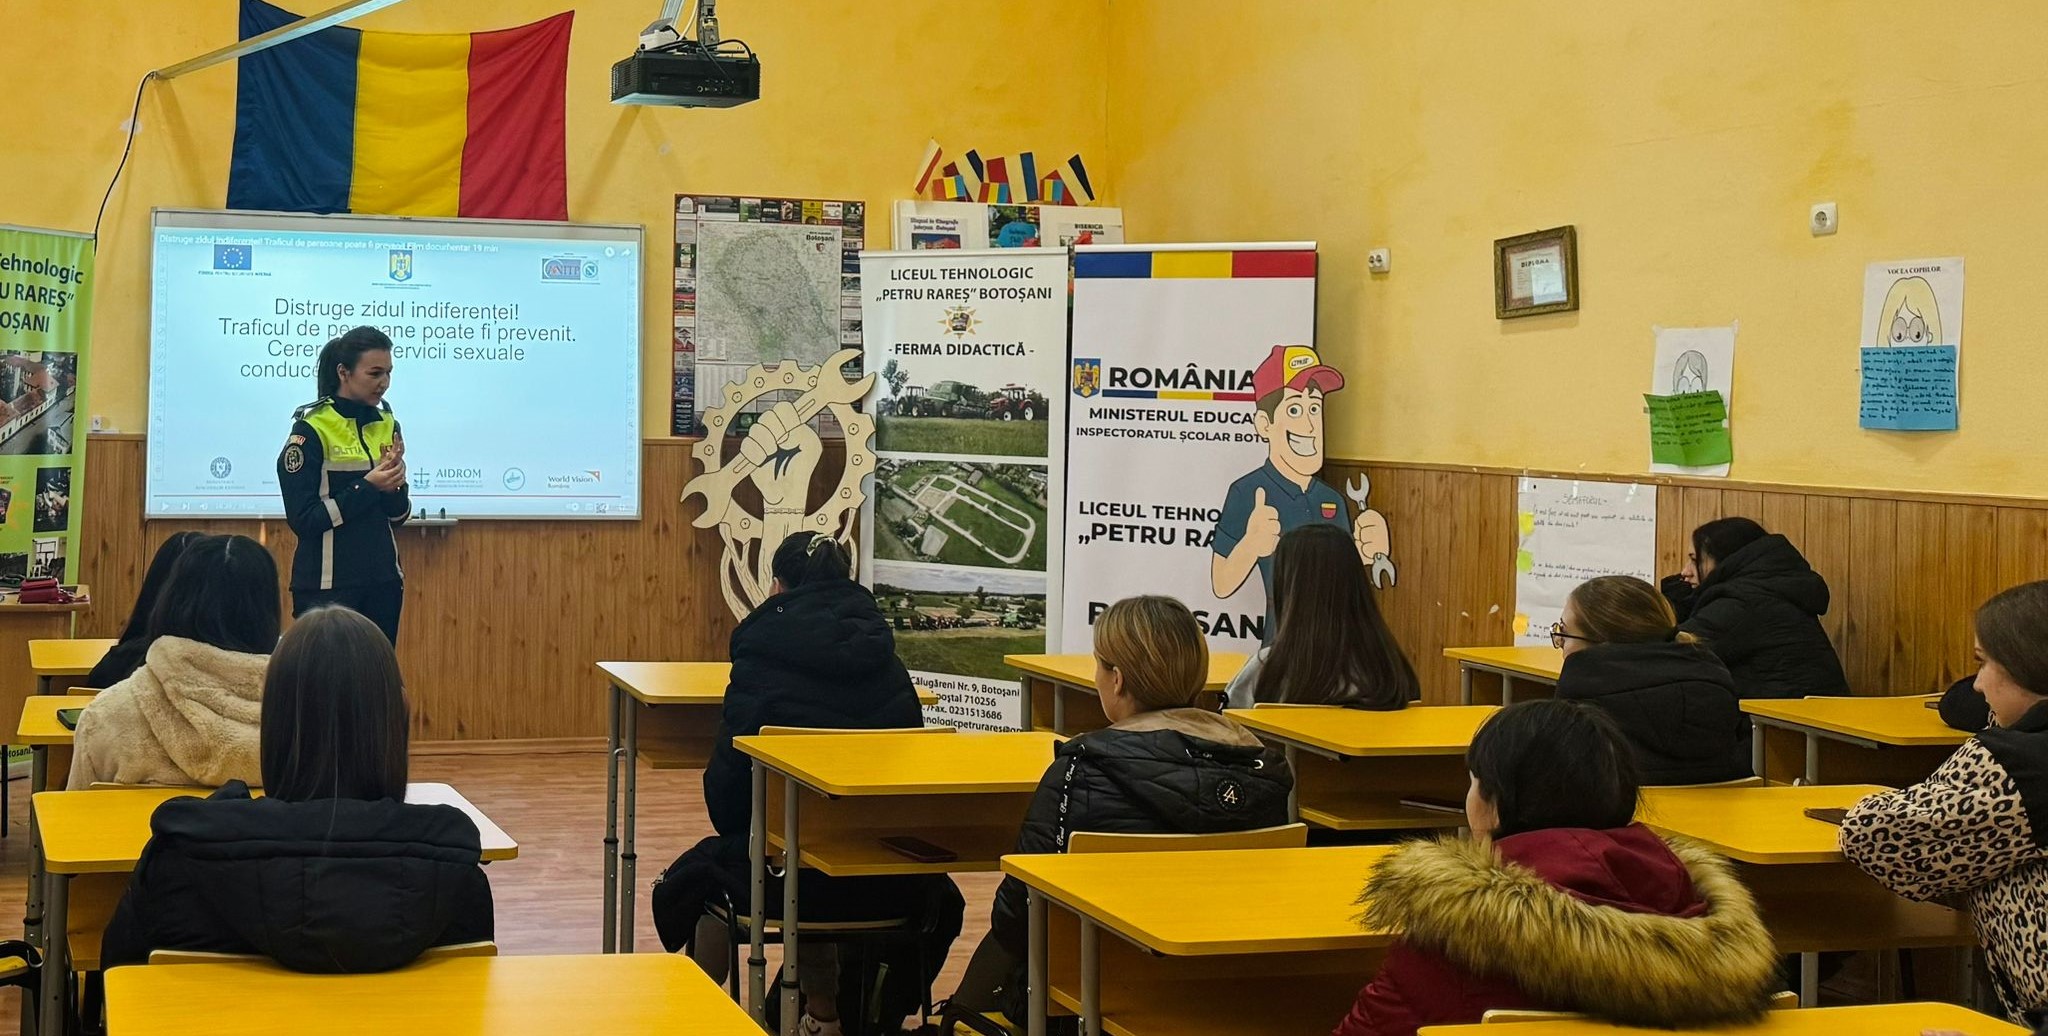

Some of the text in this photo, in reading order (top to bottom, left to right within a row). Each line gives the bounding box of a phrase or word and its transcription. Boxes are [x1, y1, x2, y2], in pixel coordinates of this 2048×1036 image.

[159, 235, 194, 246] Distruge
[195, 236, 214, 244] zidul
[264, 238, 293, 246] Traficul
[295, 239, 305, 247] de
[307, 240, 343, 250] persoane
[473, 244, 482, 252] 19
[483, 245, 499, 253] min
[0, 253, 84, 284] ehnologic
[1521, 258, 1549, 268] DIPLOMA
[1887, 267, 1908, 275] VOCEA
[891, 267, 1034, 281] LICEUL TEHNOLOGIC
[979, 287, 1052, 303] BOTOȘANI
[274, 298, 519, 324] Distruge zidul indiferenței!
[219, 317, 577, 344] Traficul de peane poate fi prevenit.
[267, 340, 525, 361] Cerer ervicii sexuale
[895, 343, 942, 355] FERMA
[946, 341, 1026, 356] DIDACTICĂ
[1109, 363, 1255, 391] ROMÂNIA
[1089, 407, 1255, 425] MINISTERUL EDUCA
[1076, 427, 1177, 440] INSPECTORATUL
[1179, 430, 1231, 443] ȘCOLAR
[436, 469, 481, 479] AIDROM
[548, 475, 593, 483] World Vision
[1079, 501, 1222, 523] LICEUL TEHNO
[1185, 528, 1216, 548] RA
[957, 681, 970, 692] Nr.
[971, 683, 980, 694] 9,
[964, 695, 997, 707] 710256
[949, 706, 1003, 720] 0231513686
